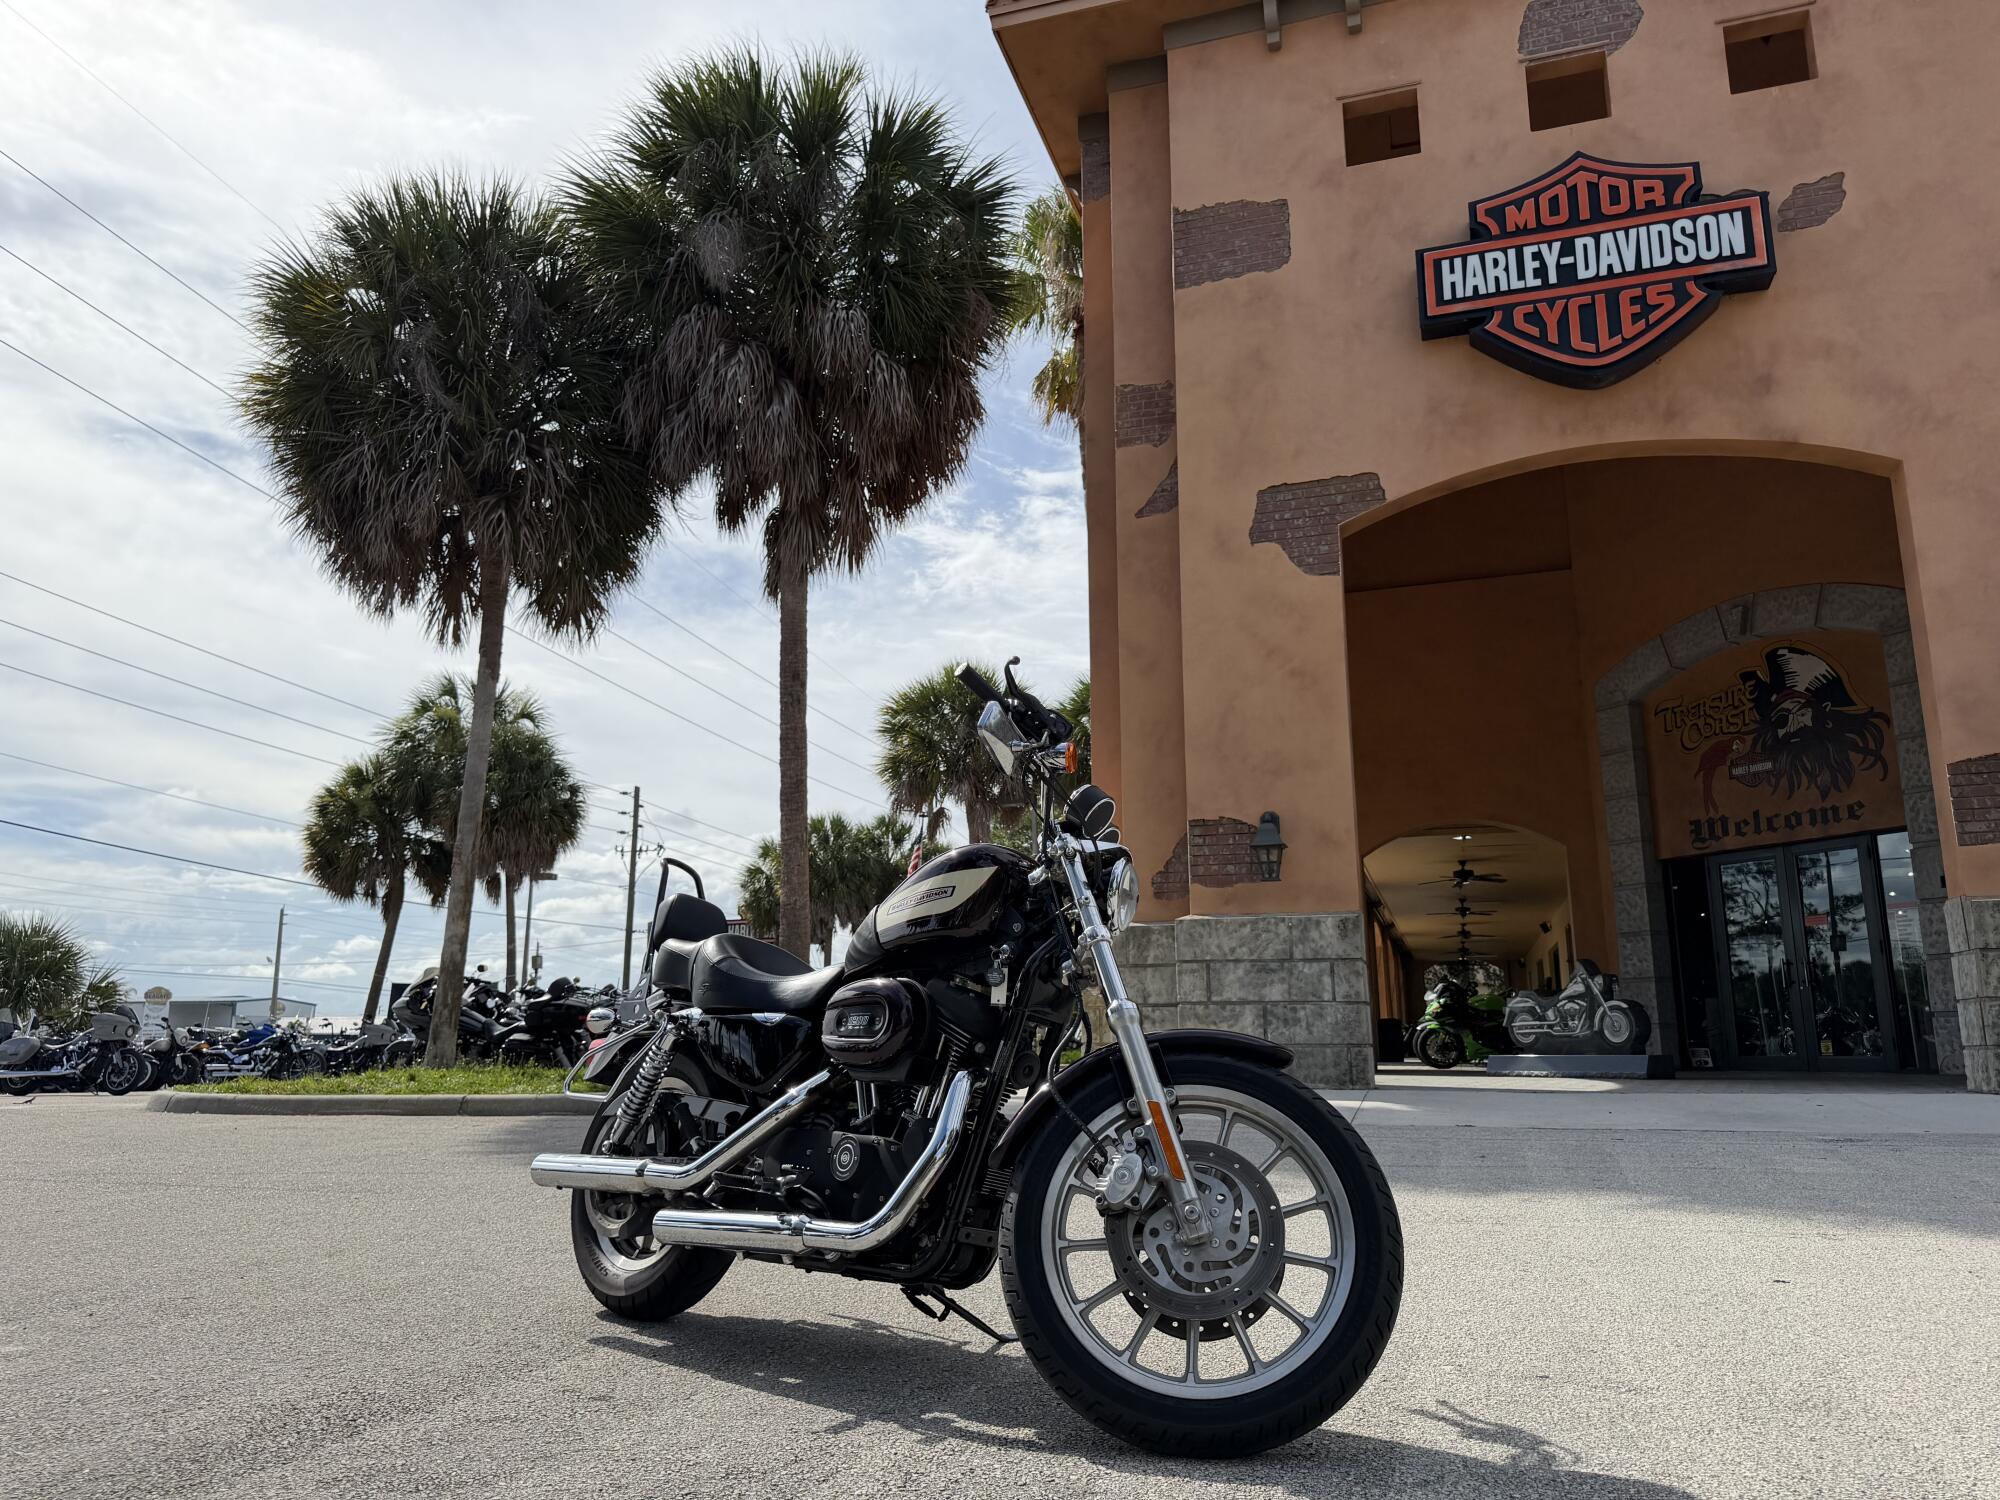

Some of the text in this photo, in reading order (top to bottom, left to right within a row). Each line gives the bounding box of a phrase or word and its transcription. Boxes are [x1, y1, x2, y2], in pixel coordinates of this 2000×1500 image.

[1505, 170, 1665, 232] MOTOR
[1441, 211, 1746, 301] HARLEY-DAVIDSON
[1513, 283, 1676, 353] CYCLES
[1688, 799, 1865, 850] Welcome
